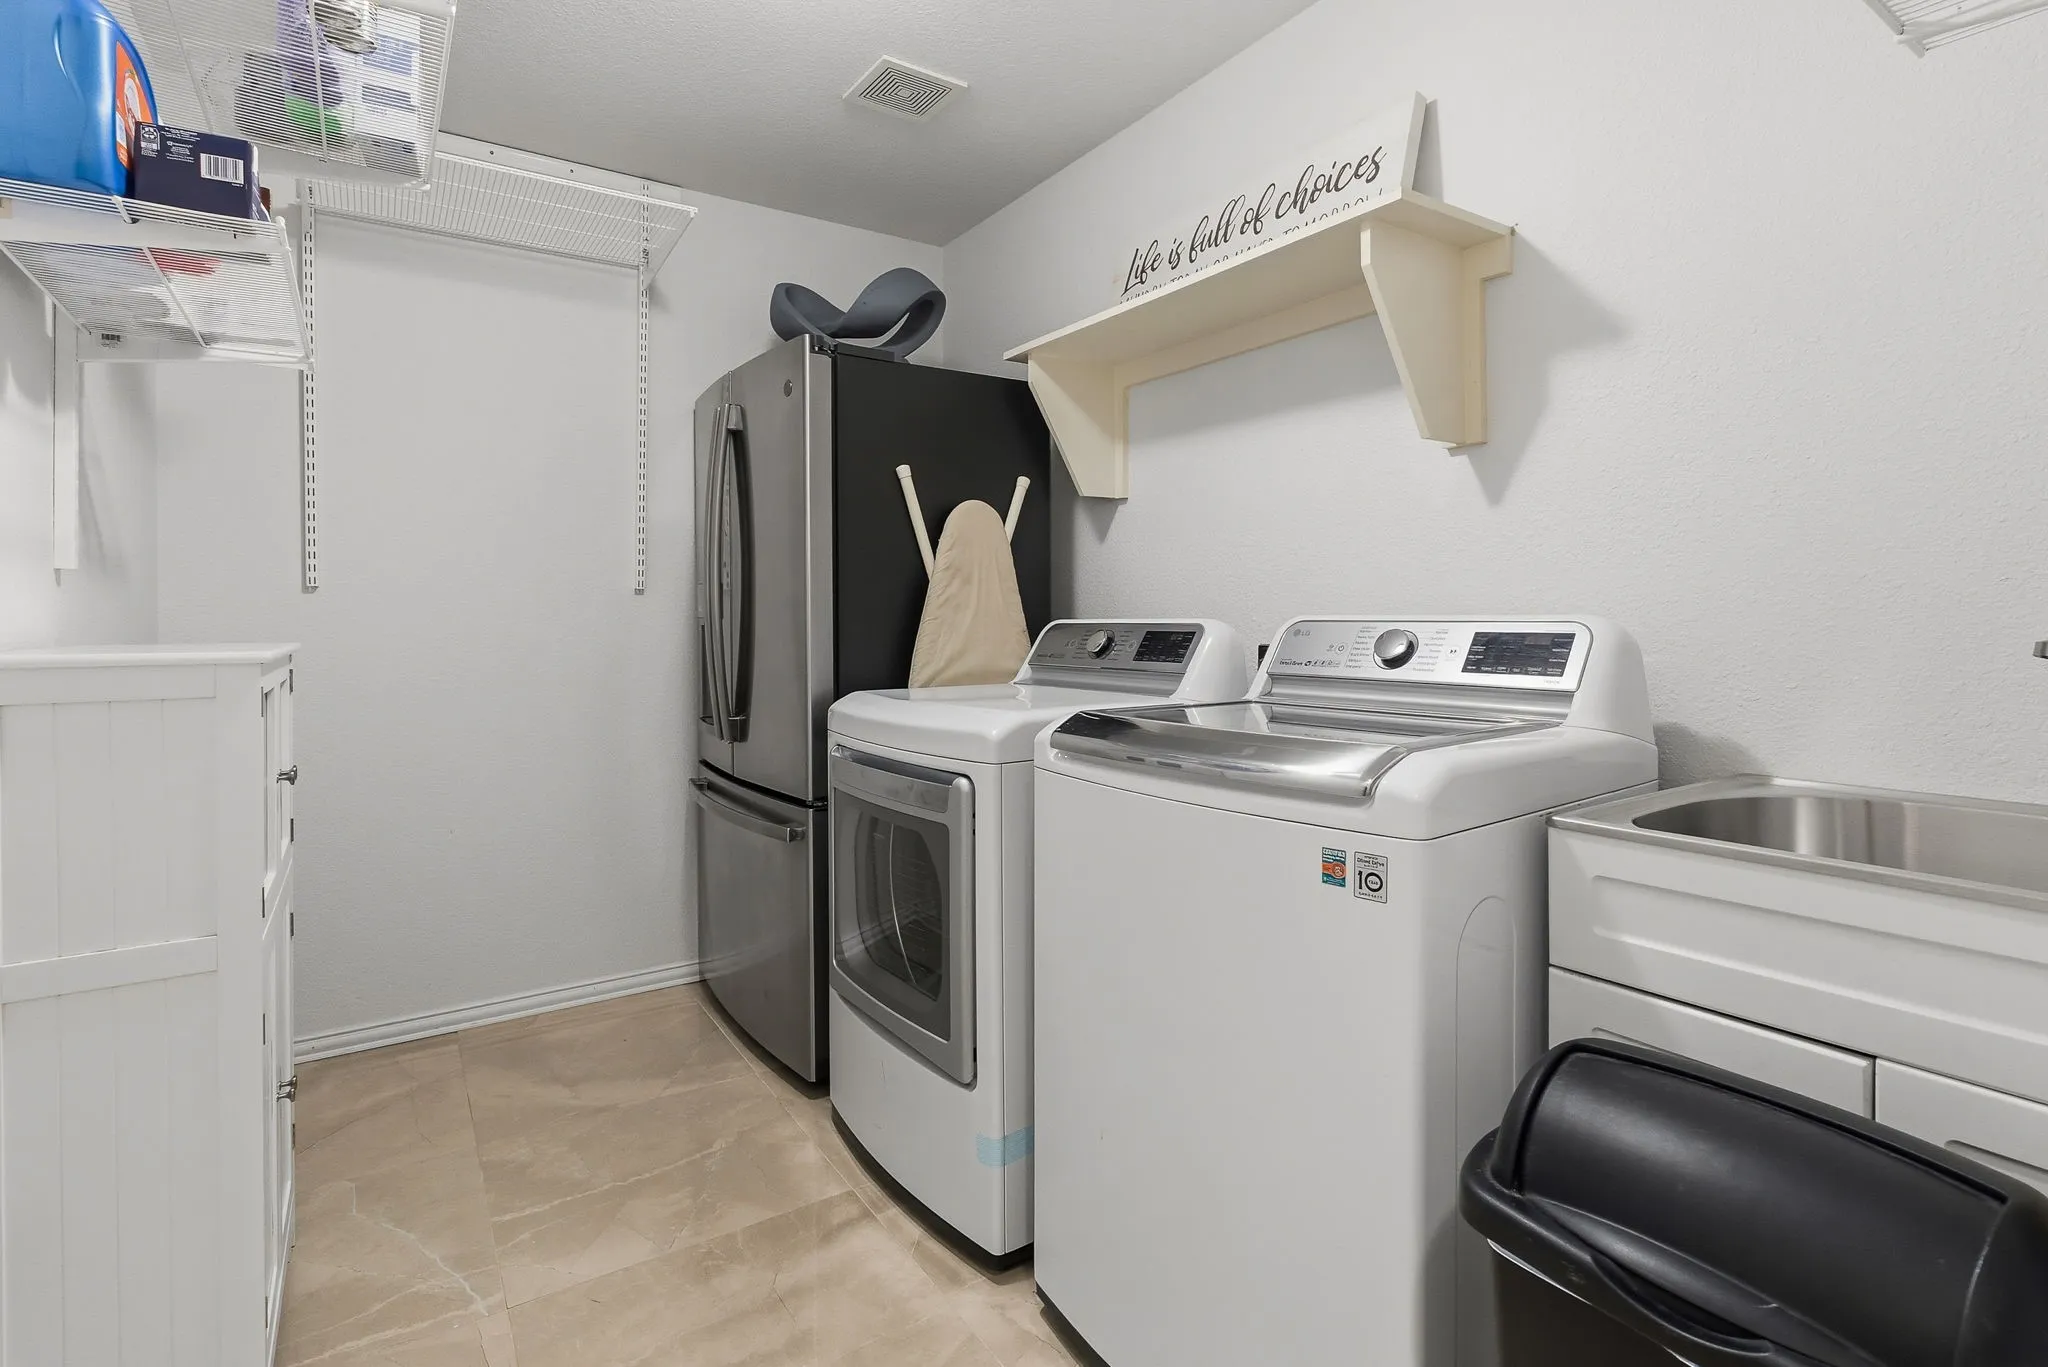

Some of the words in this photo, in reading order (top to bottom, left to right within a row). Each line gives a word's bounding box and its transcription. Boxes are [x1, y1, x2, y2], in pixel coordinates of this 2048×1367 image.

[1120, 239, 1163, 297] Life
[1168, 238, 1186, 270] is
[1189, 194, 1246, 263] full
[1240, 183, 1276, 235] of
[1275, 146, 1388, 220] choices
[1357, 870, 1384, 893] 10
